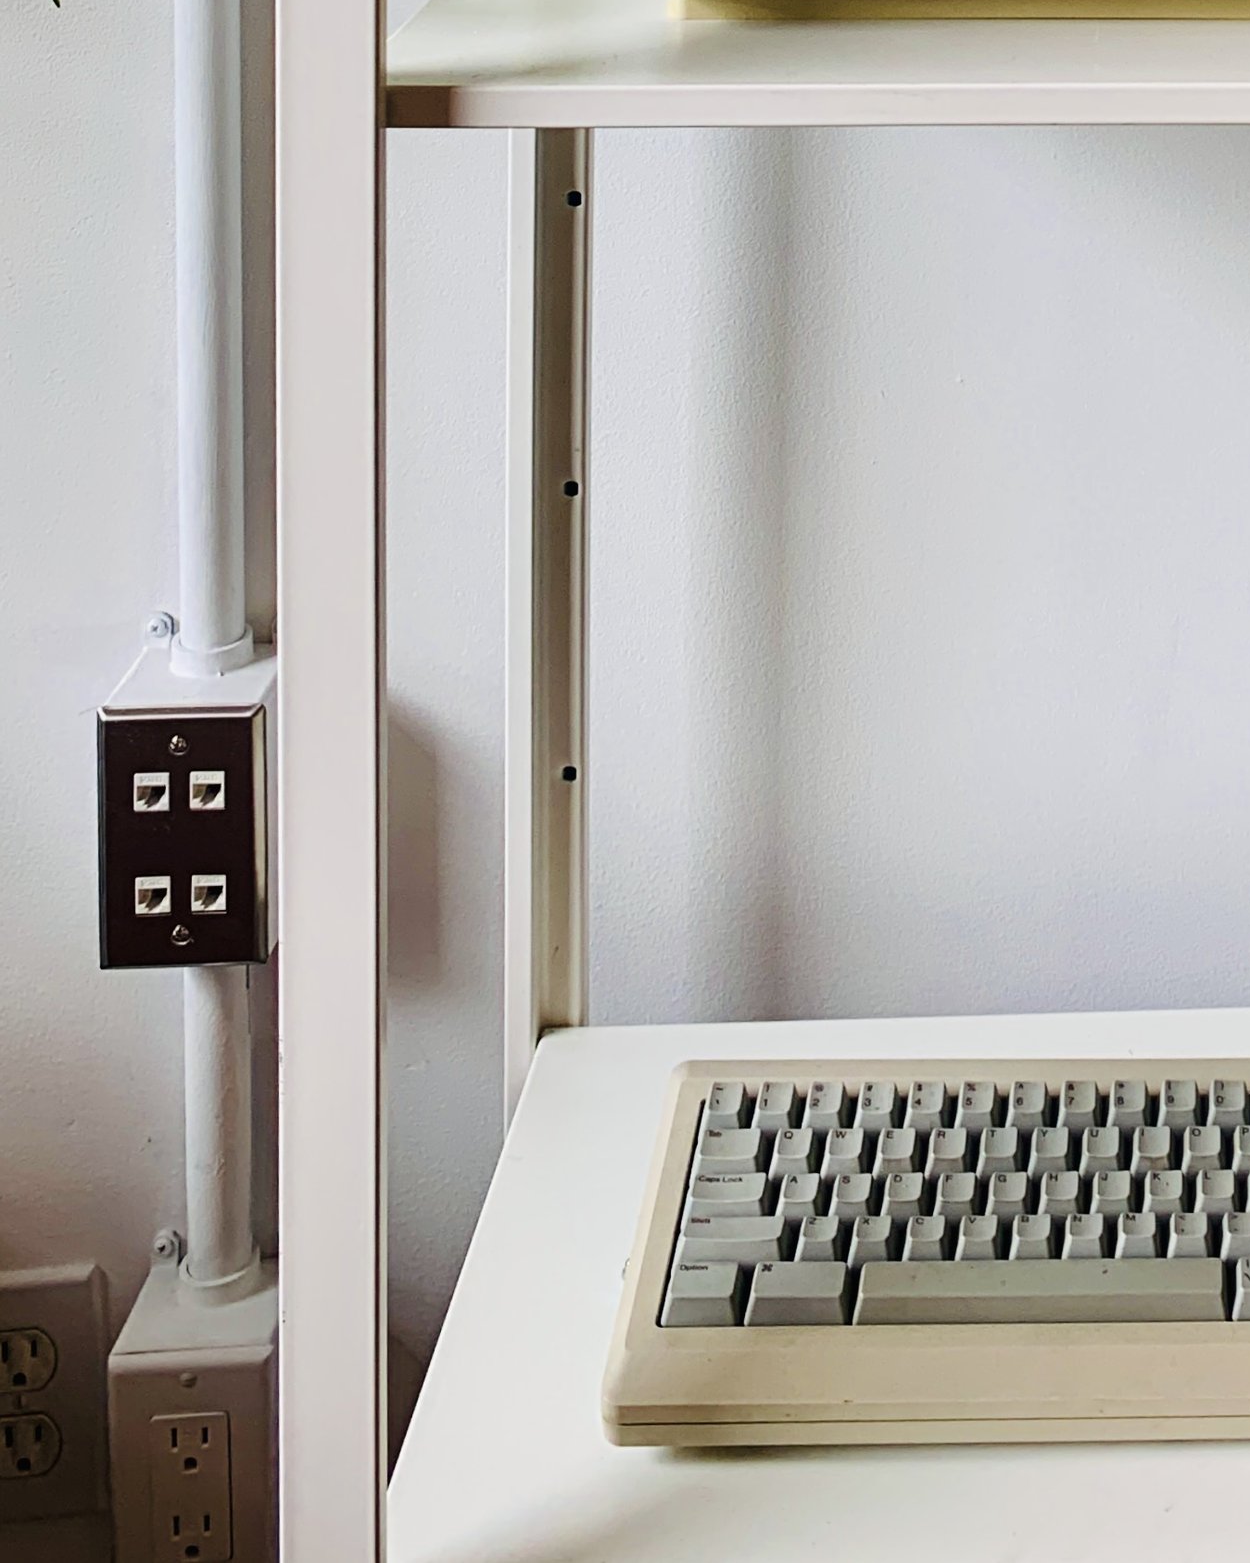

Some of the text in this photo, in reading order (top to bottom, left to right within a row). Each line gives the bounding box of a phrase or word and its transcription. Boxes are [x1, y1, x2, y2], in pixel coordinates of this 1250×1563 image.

[812, 1098, 819, 1106] 2
[864, 1098, 871, 1106] 3
[966, 1097, 972, 1106] 5
[1016, 1097, 1023, 1105] 6
[1068, 1097, 1074, 1105] 7
[1117, 1096, 1124, 1105] 8
[784, 1131, 793, 1139] Q
[835, 1130, 846, 1138] W
[886, 1131, 893, 1139] E
[937, 1130, 945, 1138] R
[990, 1129, 996, 1138] T
[1040, 1129, 1048, 1137] Y
[1090, 1129, 1099, 1137] U
[1192, 1128, 1201, 1136] O
[1242, 1127, 1249, 1135] P
[698, 1175, 720, 1183] Caps
[894, 1174, 902, 1182] D
[998, 1174, 1006, 1182] G
[1050, 1173, 1058, 1181] H
[1205, 1171, 1211, 1179] L
[842, 1176, 850, 1184] S
